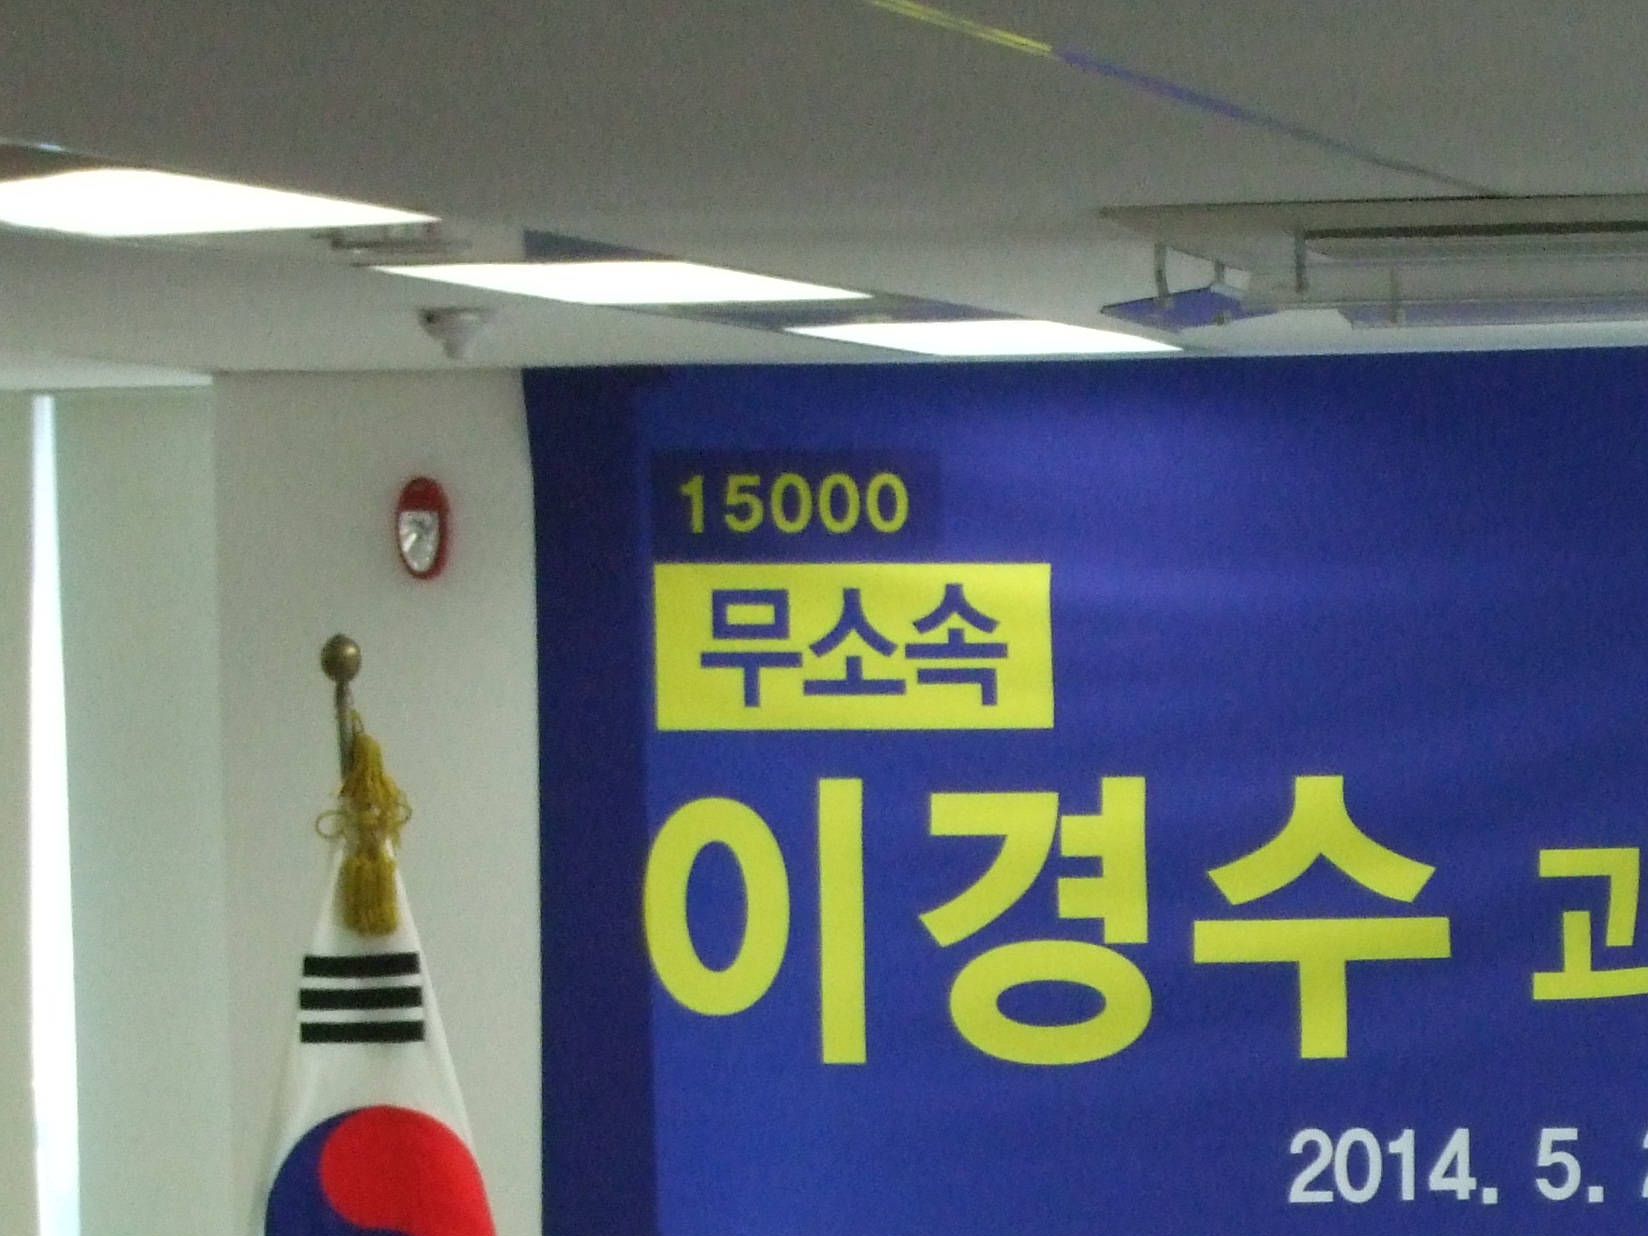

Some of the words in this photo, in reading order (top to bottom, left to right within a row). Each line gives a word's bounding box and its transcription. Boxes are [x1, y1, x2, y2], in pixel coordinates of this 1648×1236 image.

[679, 471, 910, 534] 15000
[699, 583, 1009, 708] 무소속
[643, 775, 1452, 1065] 이경수
[1288, 1127, 1499, 1204] 2014.
[1535, 1127, 1604, 1203] 5.
